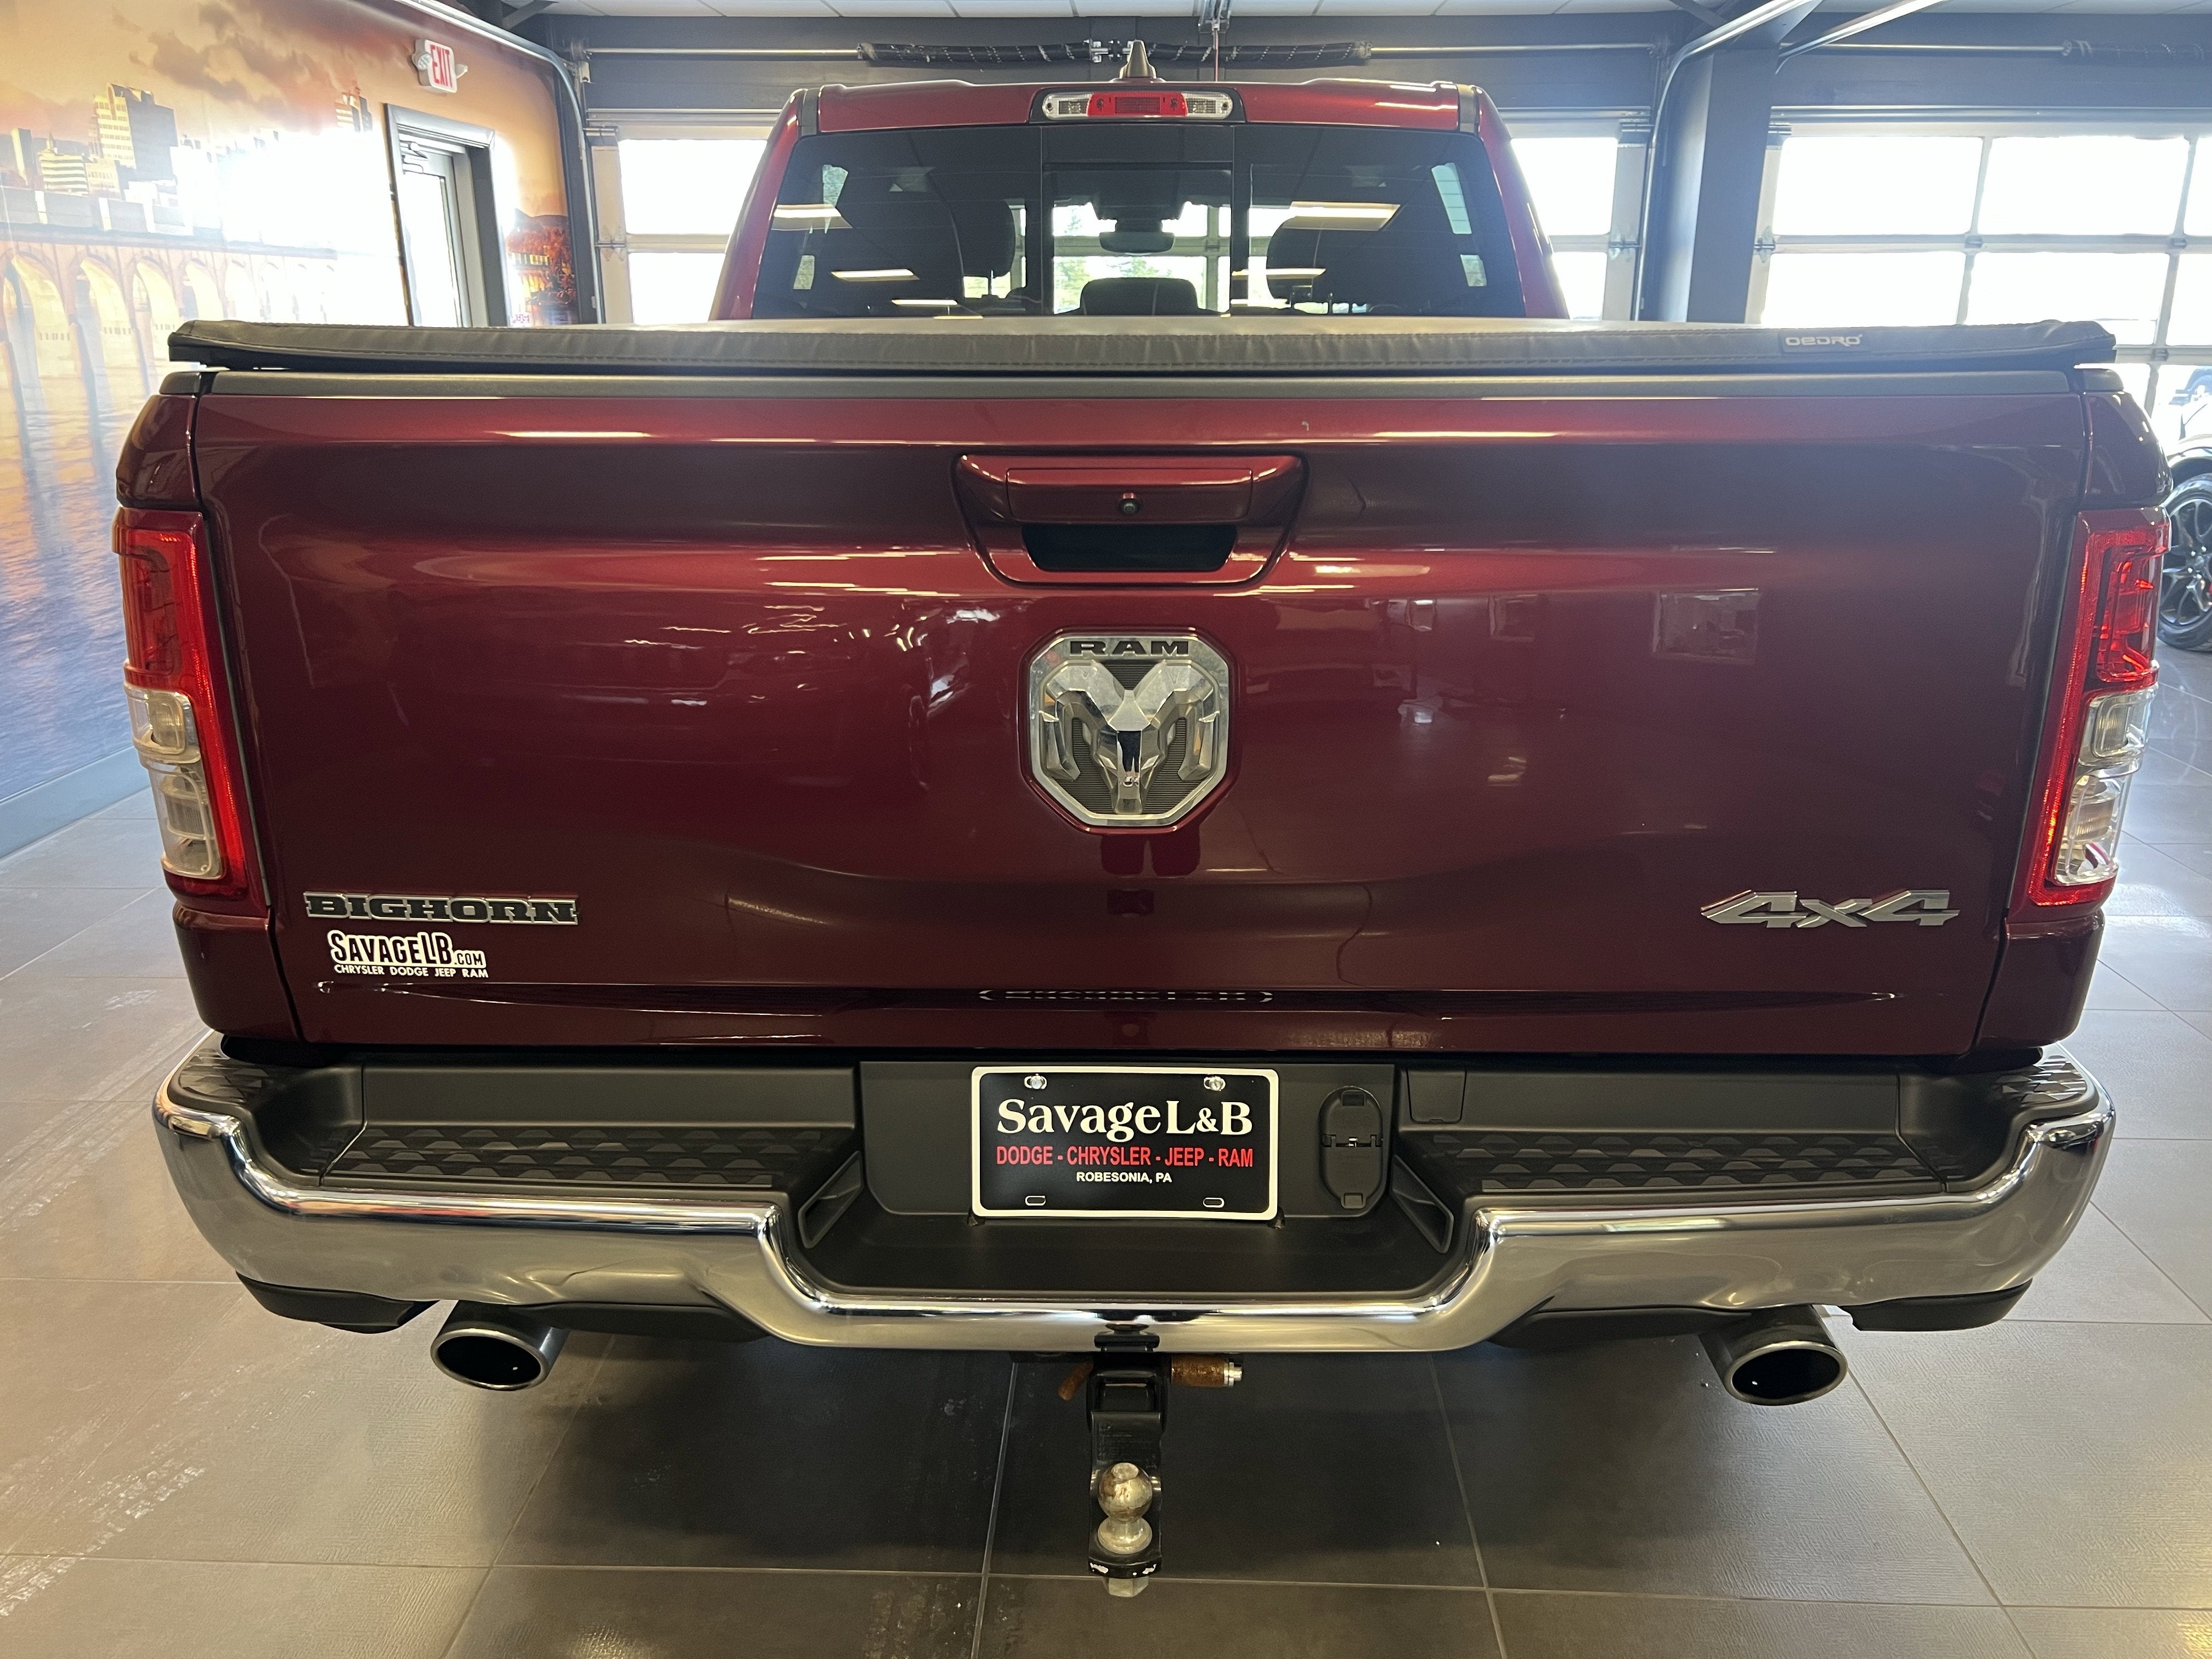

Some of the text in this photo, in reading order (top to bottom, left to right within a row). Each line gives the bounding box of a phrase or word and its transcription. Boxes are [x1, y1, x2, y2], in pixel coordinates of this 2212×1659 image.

[430, 44, 453, 88] EXIT
[1070, 641, 1189, 657] RAM
[304, 891, 579, 924] BIGHORN
[334, 964, 488, 978] CHRYSLER DODGE JEEP RAM
[997, 1099, 1252, 1143] Savage L&B
[996, 1146, 1053, 1165] DODGE
[1066, 1146, 1151, 1165] CHRYSLER
[1165, 1147, 1204, 1166] JEEP
[1218, 1148, 1253, 1167] RAM
[1076, 1172, 1172, 1183] ROBESONIA, PA
